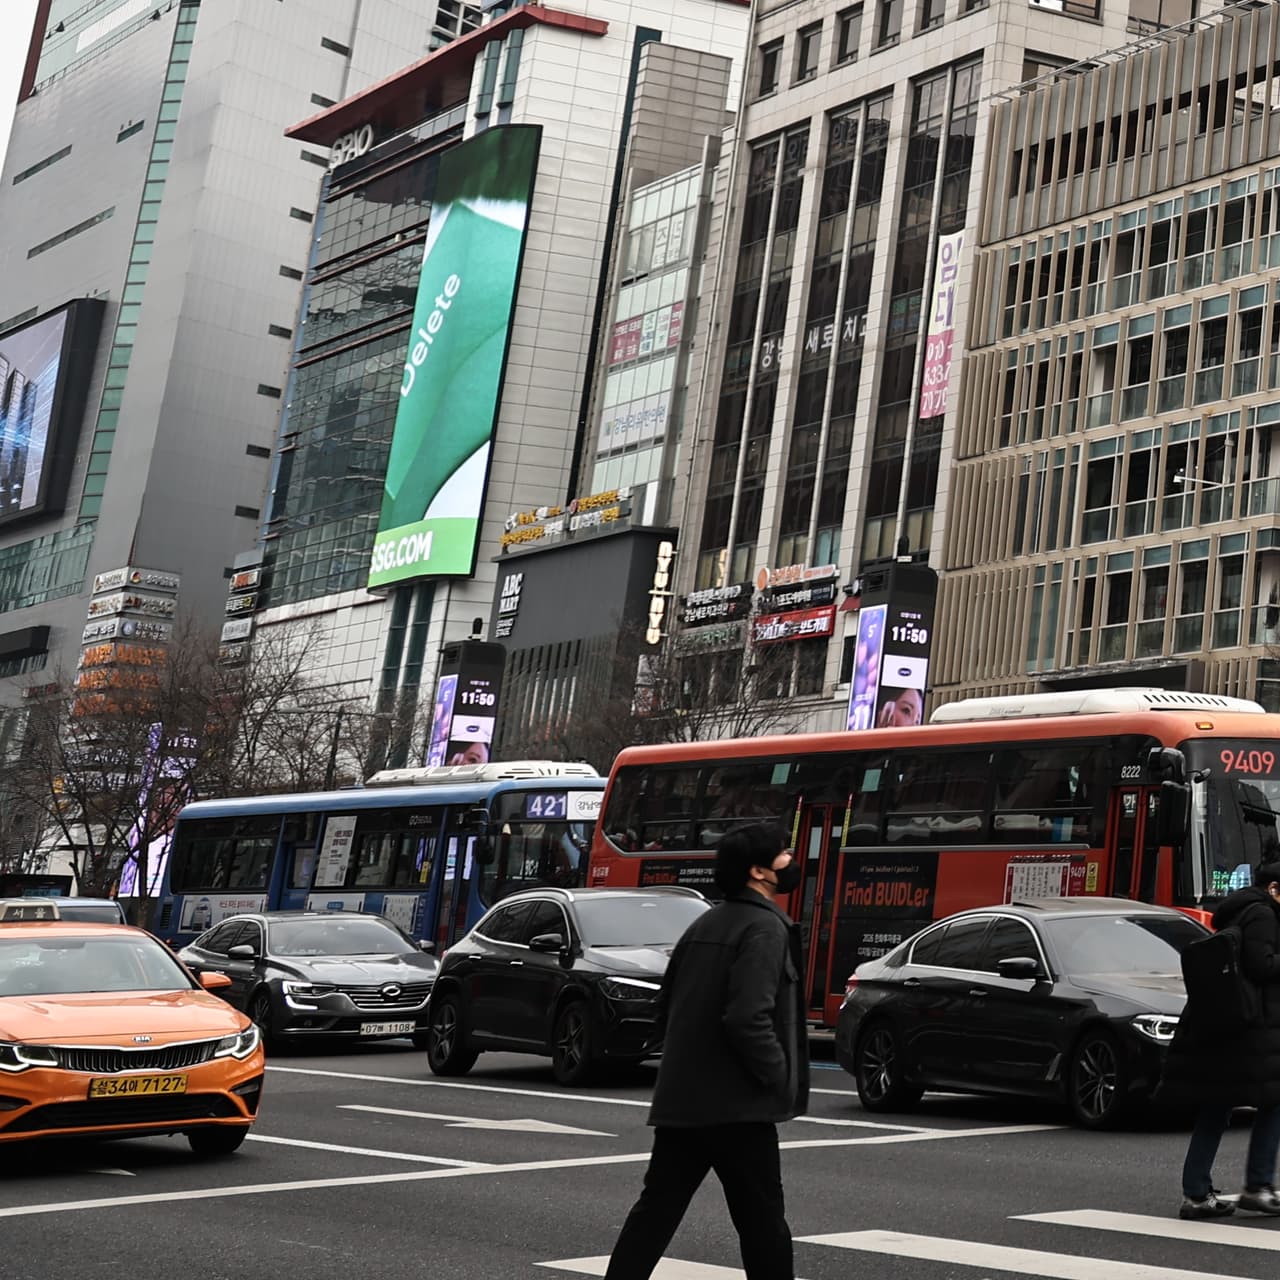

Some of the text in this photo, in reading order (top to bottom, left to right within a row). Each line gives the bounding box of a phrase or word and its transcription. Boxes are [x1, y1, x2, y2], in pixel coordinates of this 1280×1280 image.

[400, 273, 461, 397] Delete
[502, 573, 524, 598] ABC
[892, 626, 927, 645] 11:50
[461, 691, 495, 707] 11:50
[1121, 765, 1141, 778] 8222
[1220, 749, 1276, 774] 9409
[530, 794, 567, 817] 421
[844, 882, 930, 907] Find BUIDLer
[388, 1022, 411, 1033] 1108
[142, 1076, 183, 1093] 7127
